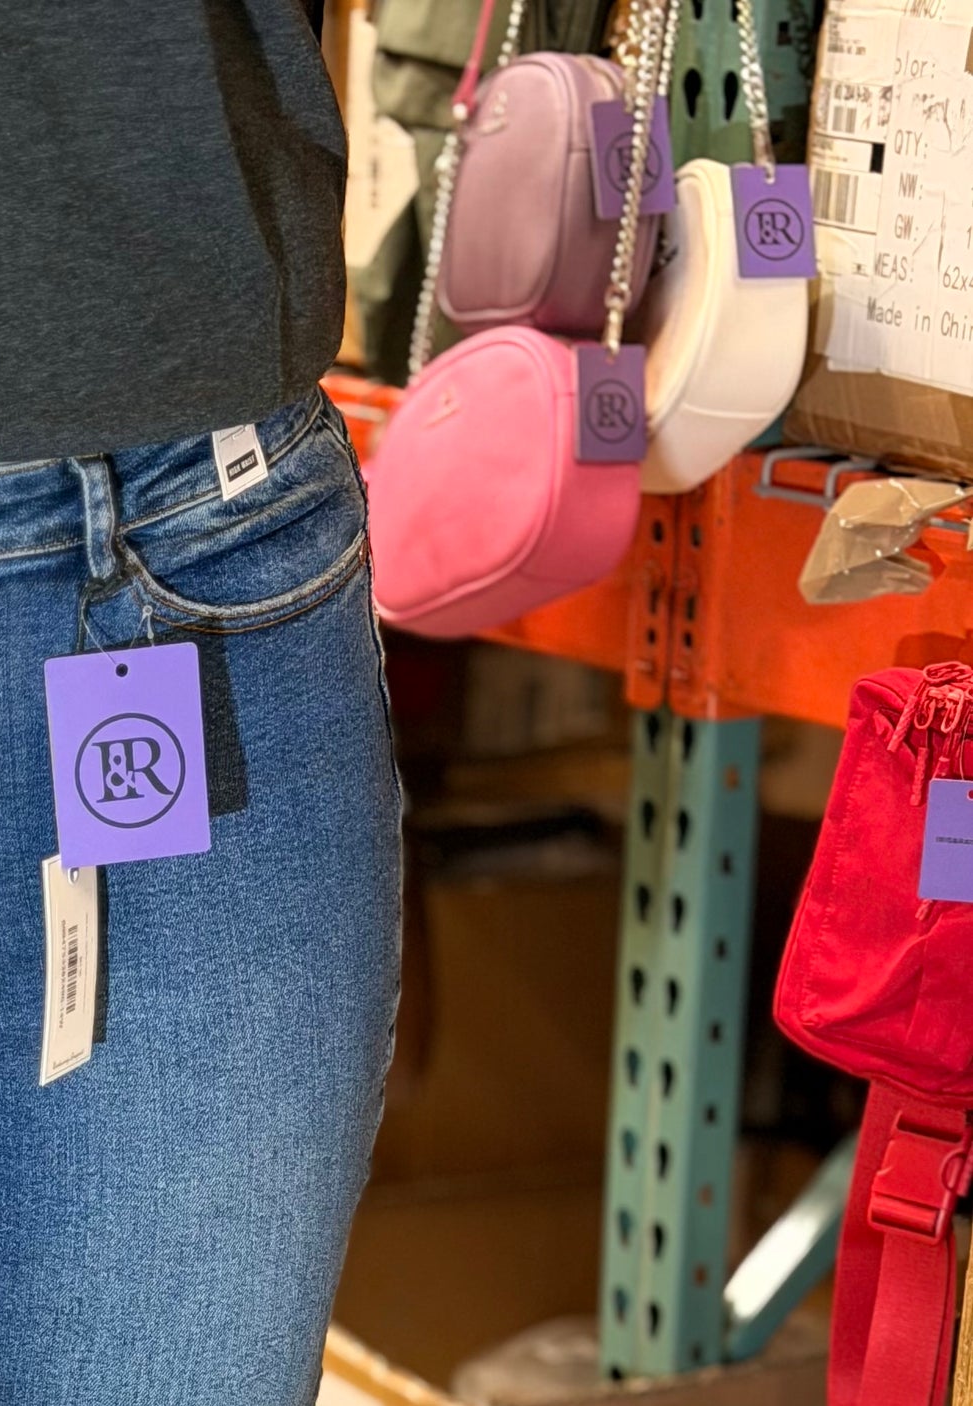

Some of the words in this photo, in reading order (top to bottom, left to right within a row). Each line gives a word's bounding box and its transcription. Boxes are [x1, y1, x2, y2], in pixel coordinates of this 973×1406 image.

[894, 129, 929, 159] QTY:
[898, 172, 923, 200] NW:
[894, 213, 919, 242] GW:
[867, 296, 902, 327] Made
[914, 306, 931, 333] in
